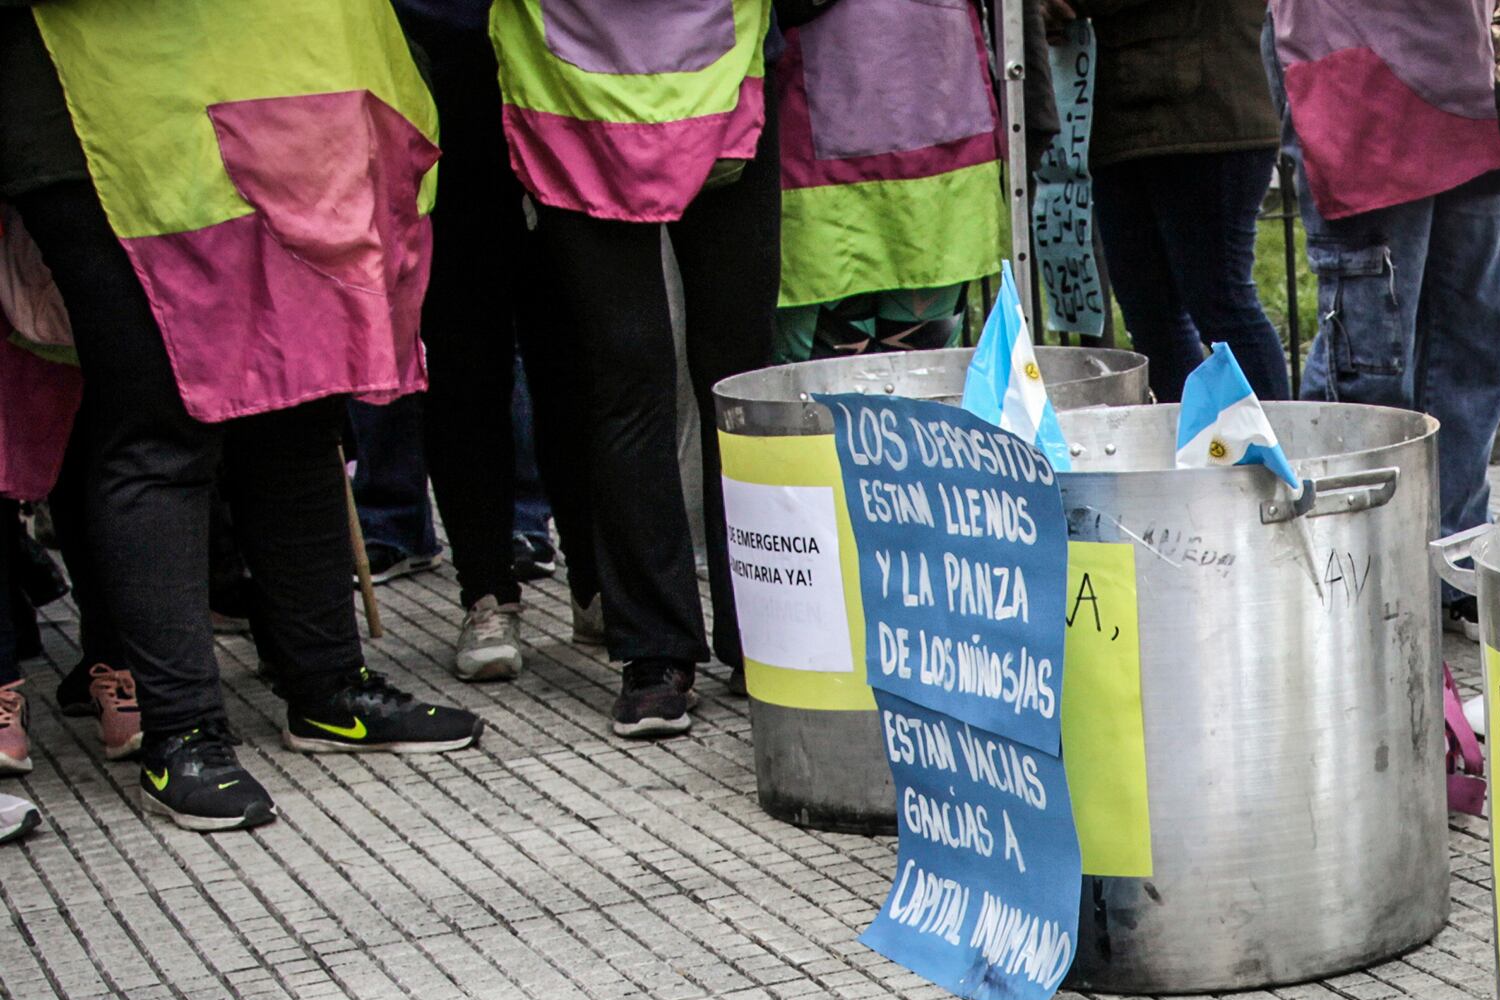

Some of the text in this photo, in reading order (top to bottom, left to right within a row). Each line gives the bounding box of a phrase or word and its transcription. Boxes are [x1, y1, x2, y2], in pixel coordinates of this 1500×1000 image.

[837, 402, 1054, 486] LOS DEPOSITOS
[737, 529, 820, 554] EMERGENCIA
[859, 478, 935, 528] ESTAN
[938, 482, 1037, 545] LLENOS
[786, 569, 813, 587] YA!
[875, 549, 1029, 623] Y LA PANZA
[878, 621, 912, 679] DE
[919, 630, 956, 692] LOS
[883, 709, 1047, 810] ESTAN VACIAS
[1003, 809, 1026, 874] A
[889, 859, 970, 946] CAPITAL
